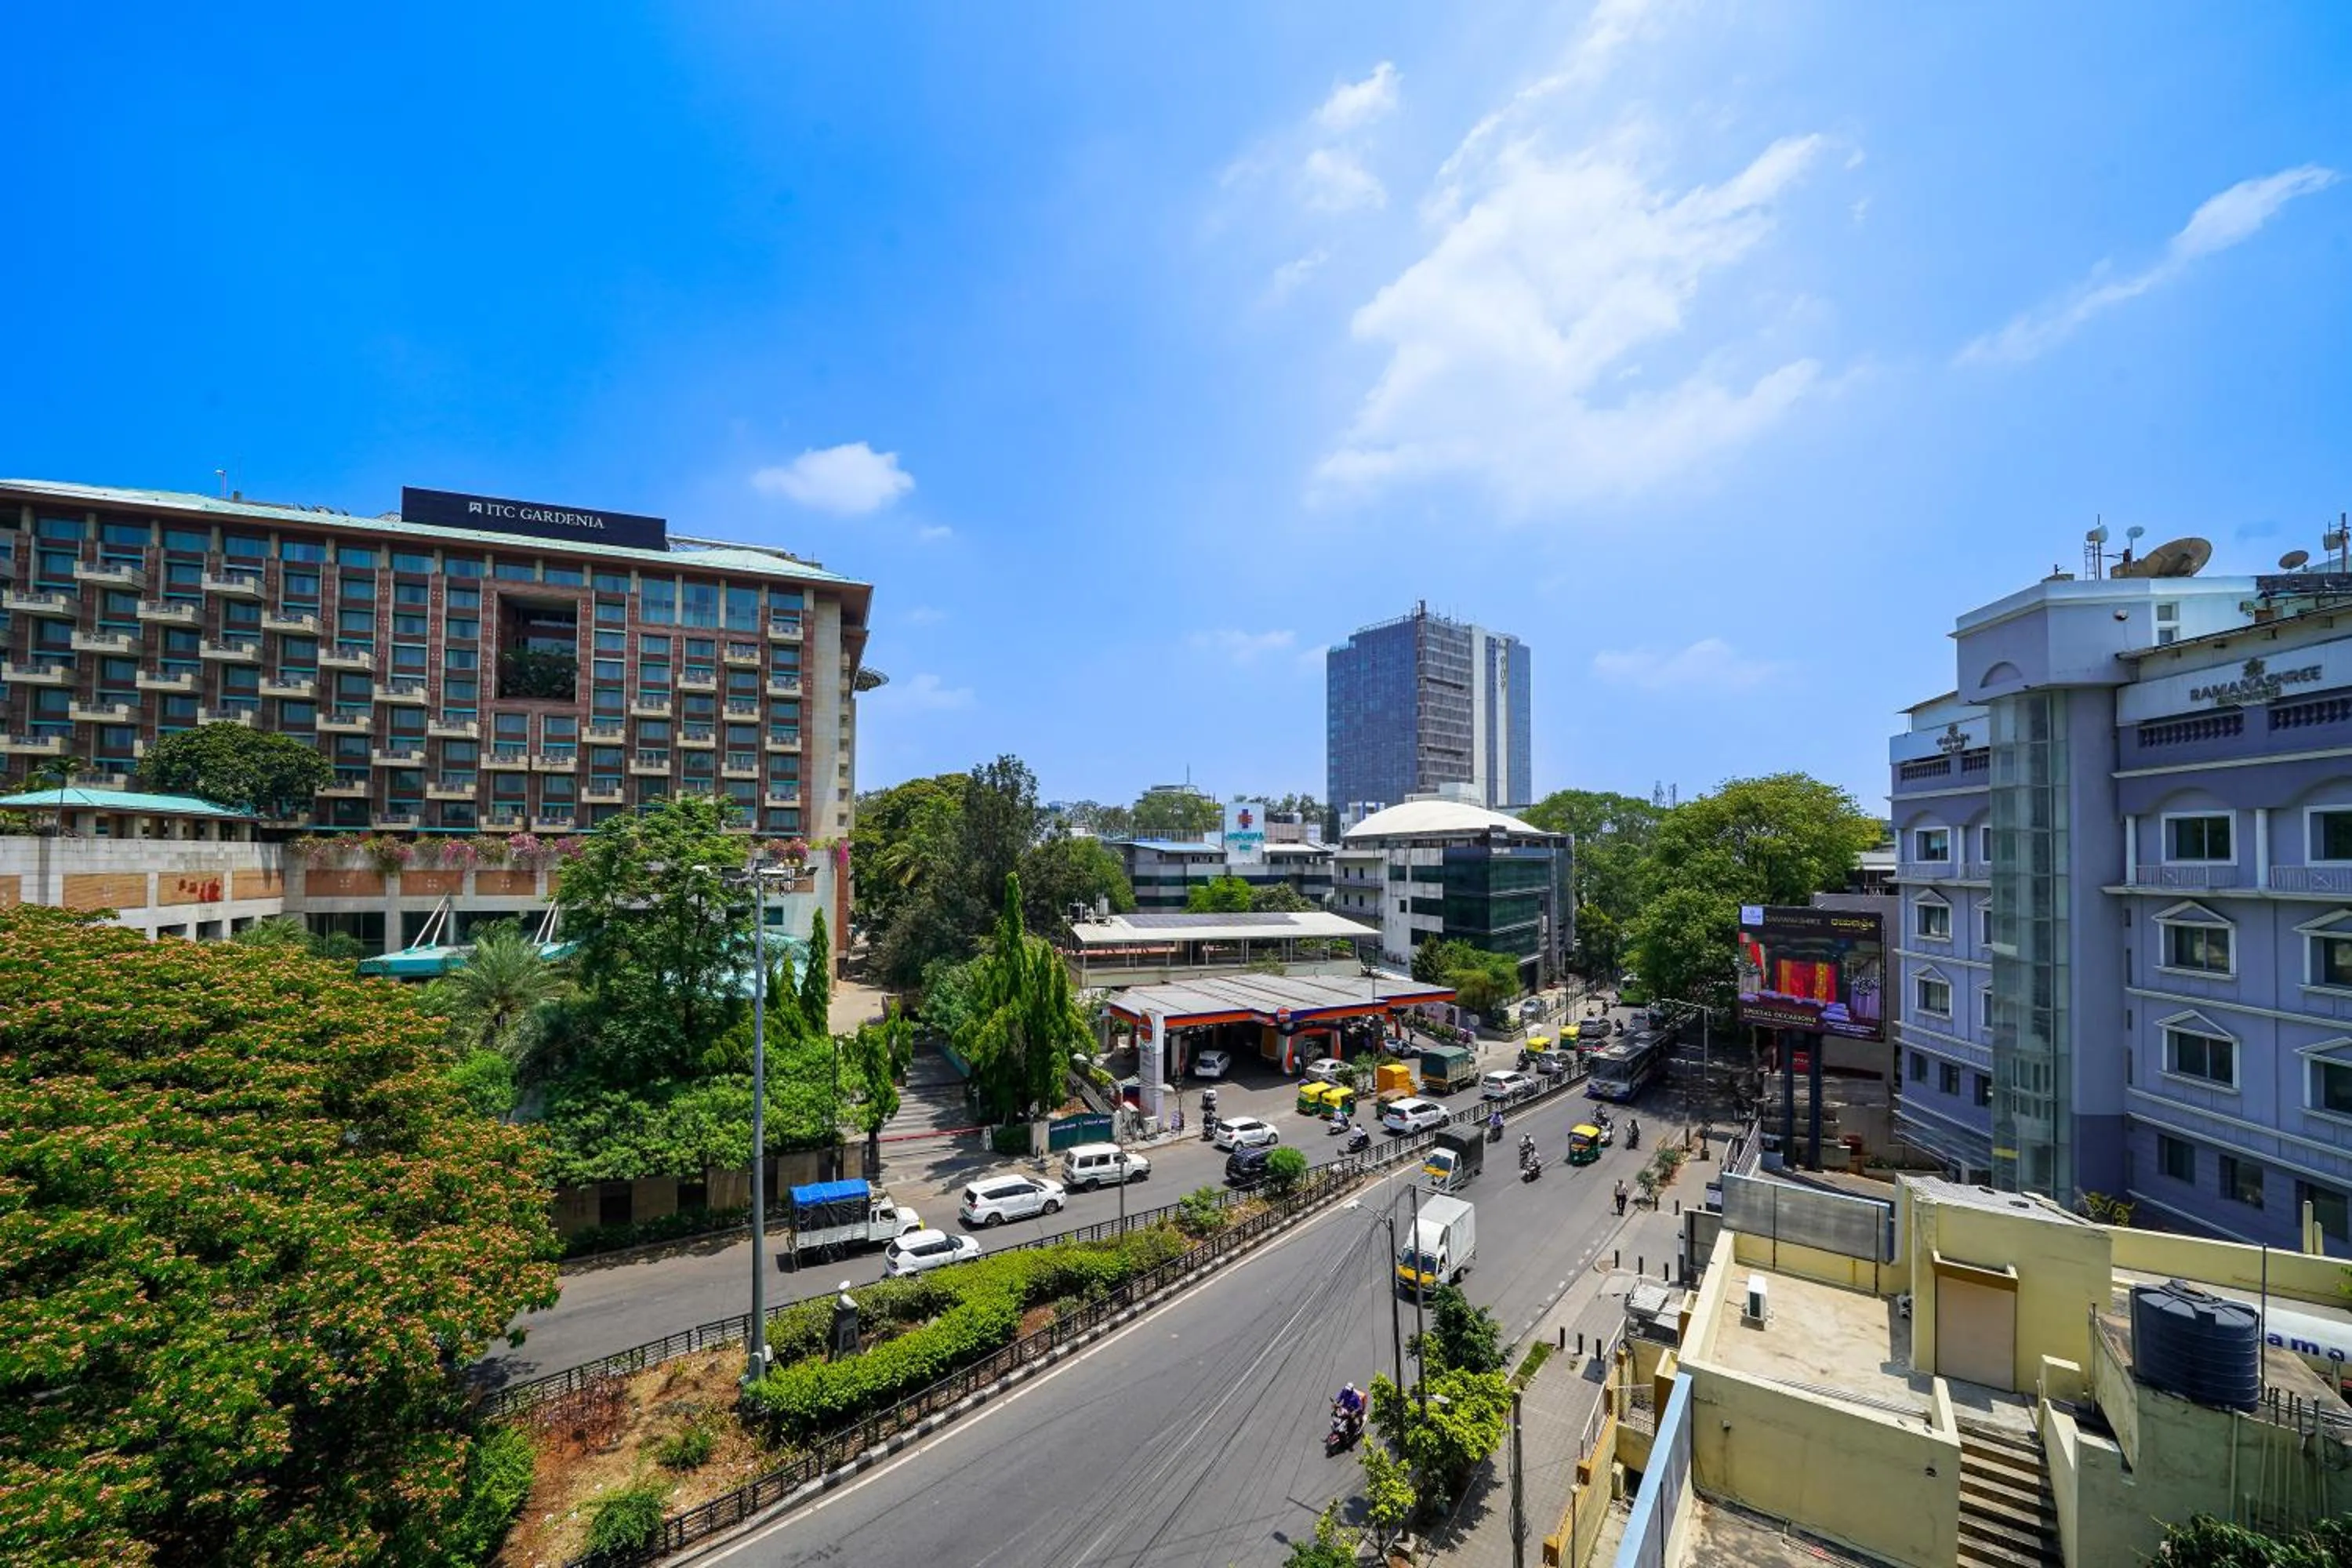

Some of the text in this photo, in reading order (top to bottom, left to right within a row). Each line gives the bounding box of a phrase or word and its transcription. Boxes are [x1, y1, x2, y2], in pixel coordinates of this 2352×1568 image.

[487, 503, 605, 529] ITC GARDENIA
[2190, 665, 2322, 702] RAMANASHREE
